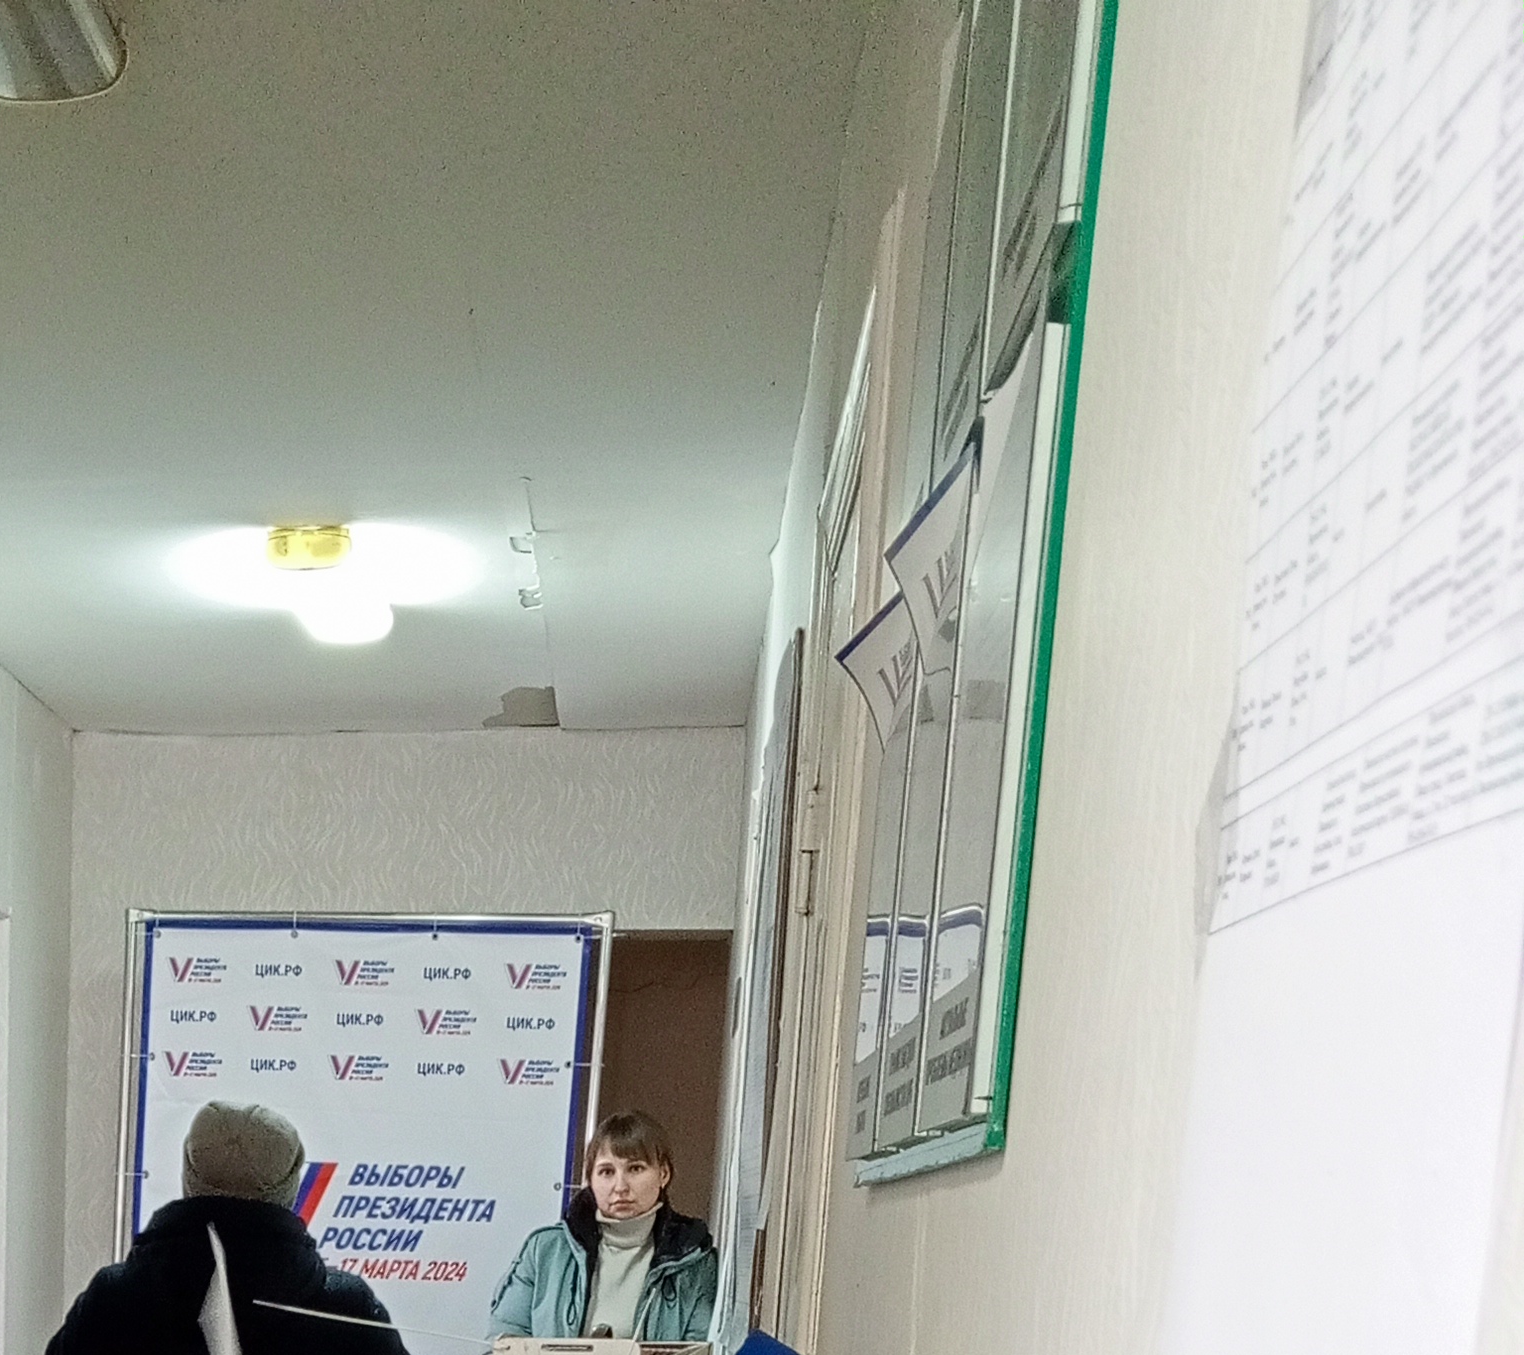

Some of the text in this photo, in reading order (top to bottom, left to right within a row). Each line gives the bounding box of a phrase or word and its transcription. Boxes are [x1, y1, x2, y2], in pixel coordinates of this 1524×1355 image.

[256, 964, 302, 978] ЦИК.РФ
[424, 968, 471, 981] ЦИК.РФ
[171, 1010, 216, 1024] ЦИК.РФ
[337, 1013, 383, 1027] ЦИК.РФ
[507, 1017, 555, 1031] ЦИК.РФ
[251, 1059, 296, 1073] ЦИК.РФ
[418, 1063, 465, 1076] ЦИК.РФ
[348, 1164, 465, 1189] ВЫБОРЫ
[333, 1196, 496, 1224] ПРЕЗИДЕНТА
[319, 1227, 423, 1252] РОССИИ
[359, 1259, 421, 1281] МАРТА
[421, 1261, 467, 1281] 2024
